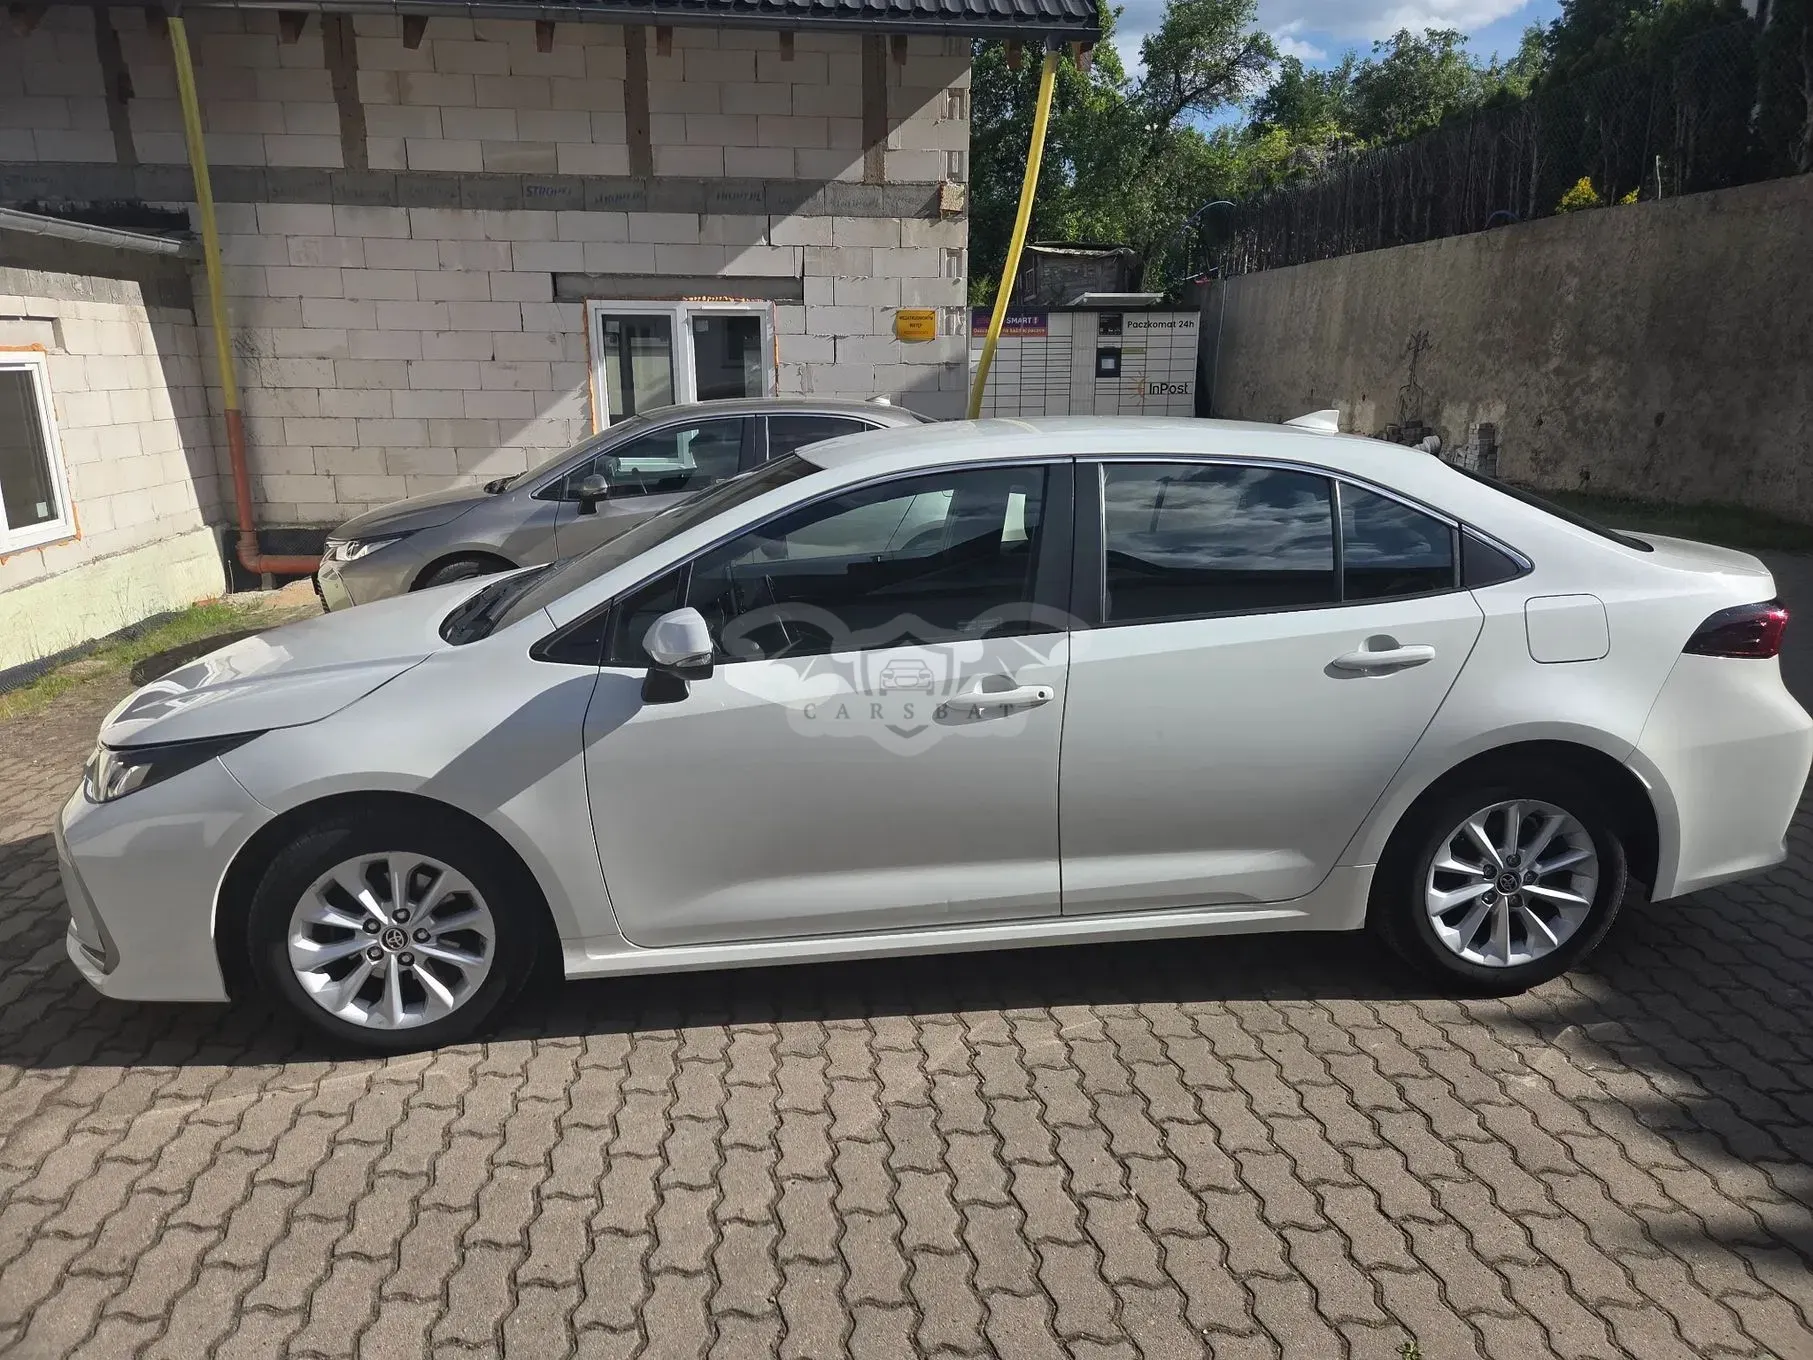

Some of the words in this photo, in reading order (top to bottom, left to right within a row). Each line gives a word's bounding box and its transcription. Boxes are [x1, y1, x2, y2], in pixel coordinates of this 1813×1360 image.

[1127, 320, 1176, 328] Paczkomat
[1178, 320, 1195, 328] 24h
[1149, 382, 1188, 395] InPost
